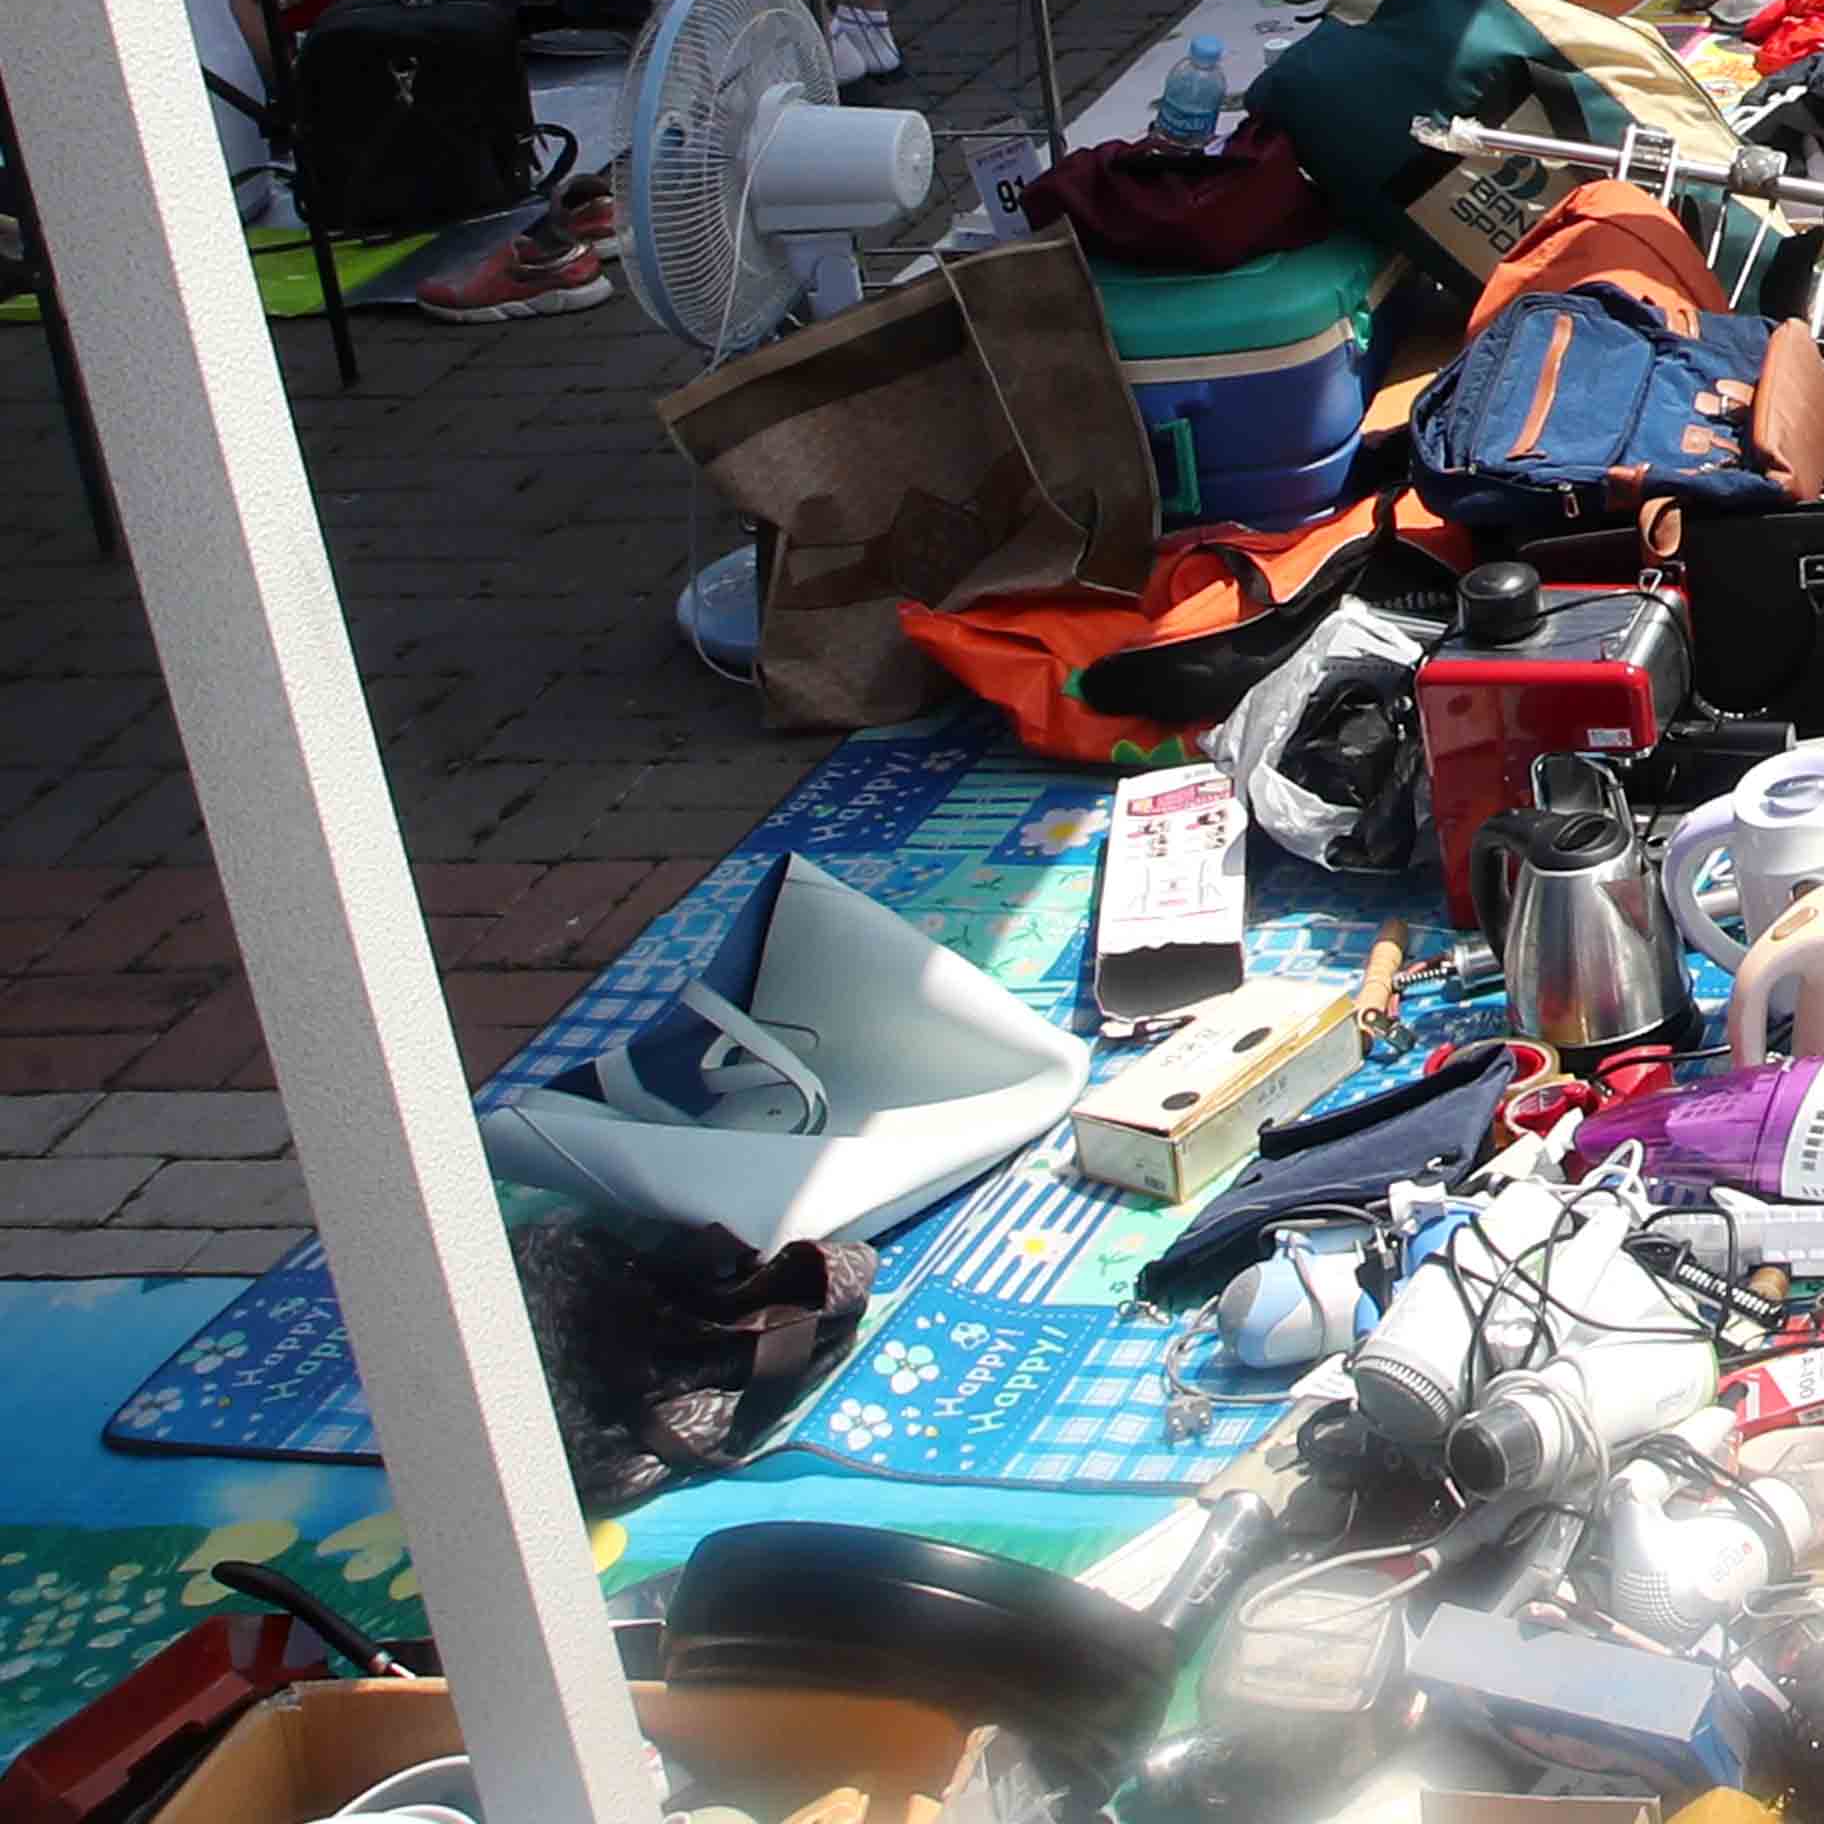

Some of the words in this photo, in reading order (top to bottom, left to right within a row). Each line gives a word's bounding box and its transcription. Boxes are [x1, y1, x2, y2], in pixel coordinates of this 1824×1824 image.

[1449, 197, 1517, 254] SPO
[1471, 174, 1535, 236] BAN
[932, 1327, 1025, 1417] Happy!
[967, 1324, 1069, 1436] Happy!
